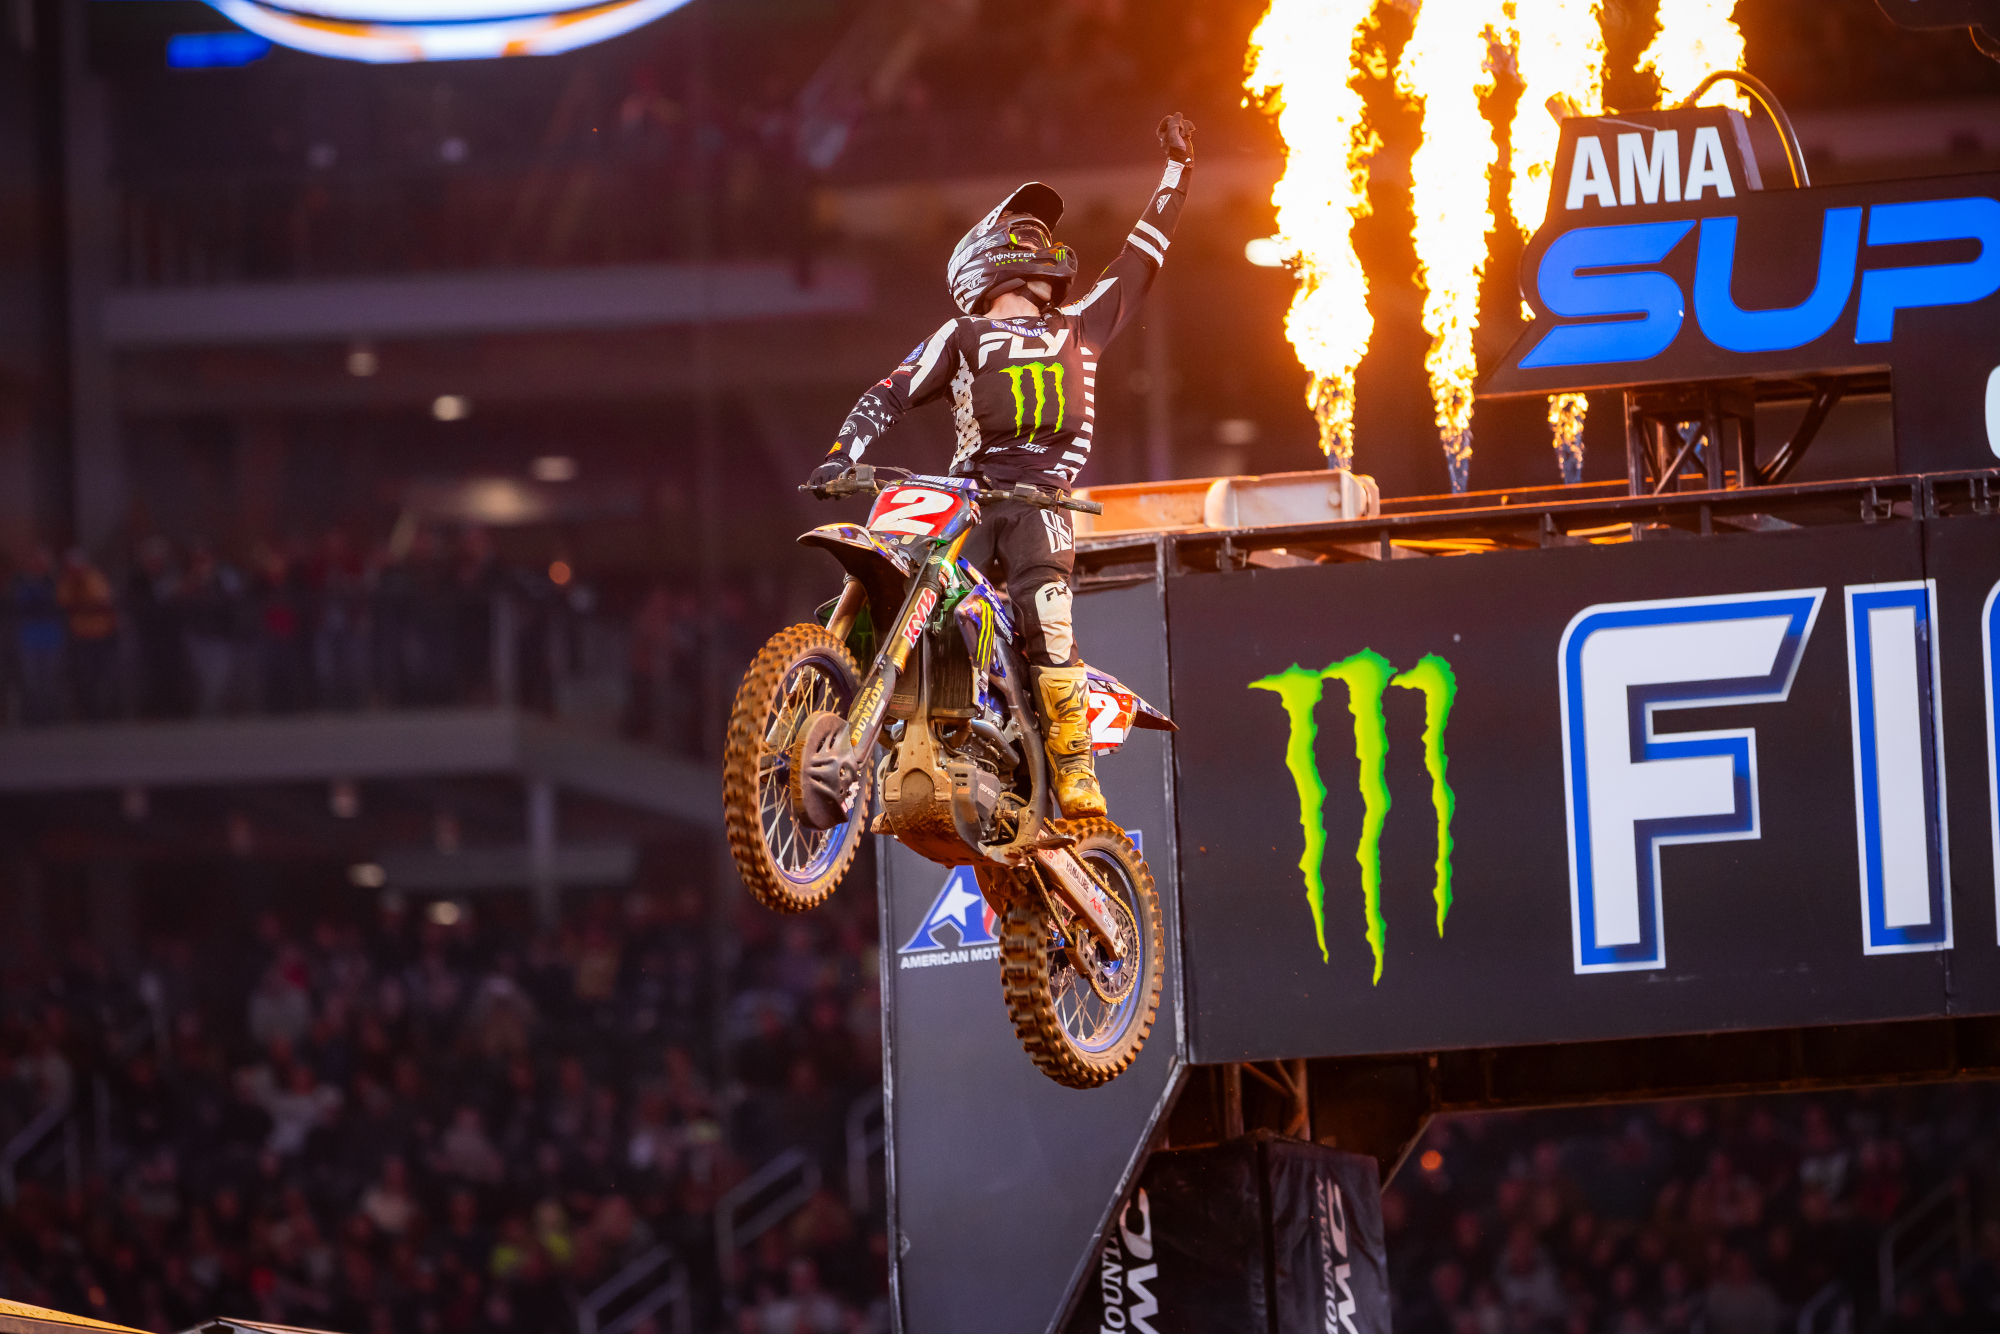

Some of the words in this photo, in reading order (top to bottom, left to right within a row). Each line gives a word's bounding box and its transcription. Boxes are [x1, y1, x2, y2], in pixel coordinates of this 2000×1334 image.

[1565, 126, 1736, 210] AMA
[1518, 196, 2000, 369] SUP
[978, 328, 1070, 370] FLY
[869, 488, 955, 536] 2
[850, 677, 885, 745] DUNLOP
[1088, 692, 1124, 744] 2
[1558, 577, 2000, 975] FI
[900, 950, 969, 970] AMERICAN
